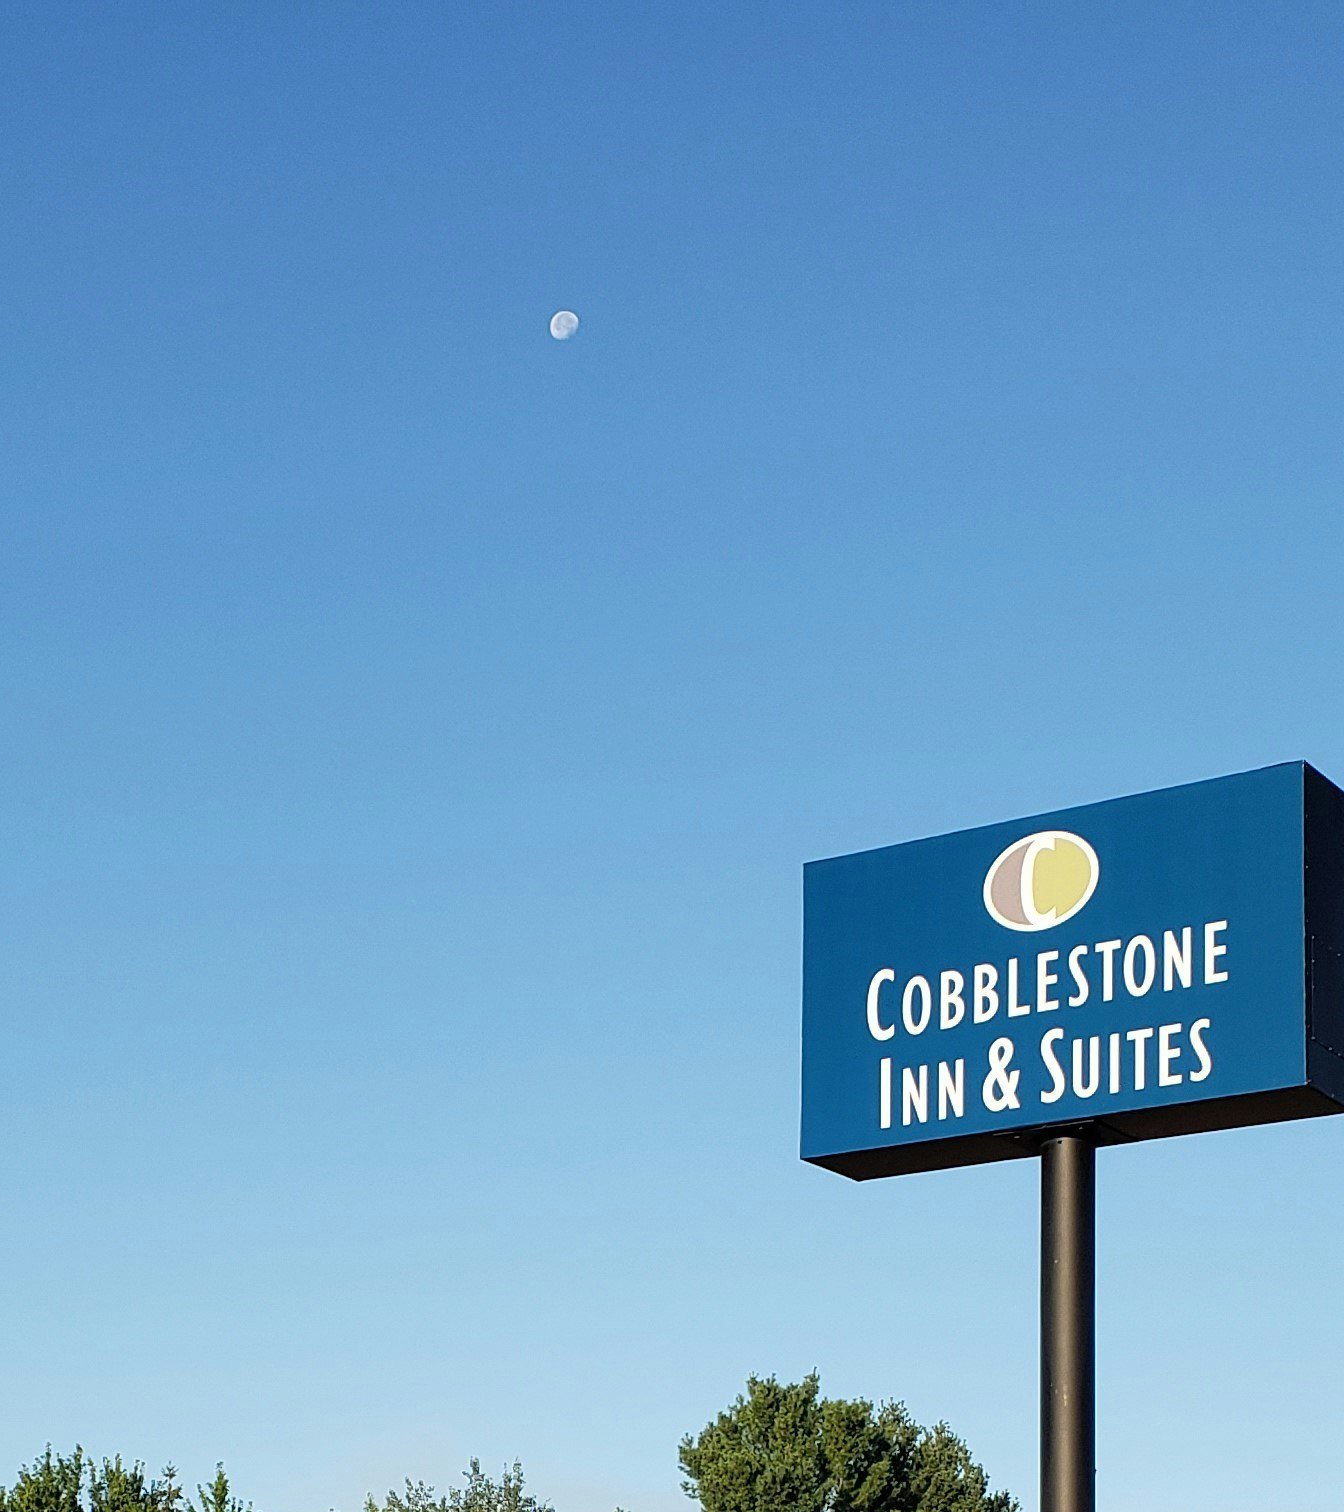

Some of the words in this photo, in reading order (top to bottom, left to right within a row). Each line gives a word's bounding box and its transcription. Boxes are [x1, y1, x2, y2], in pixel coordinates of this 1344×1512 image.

[866, 920, 1229, 1041] COBBLESTONE
[879, 1057, 965, 1129] INN
[982, 1037, 1021, 1112] &
[1039, 1018, 1212, 1104] SUITES
